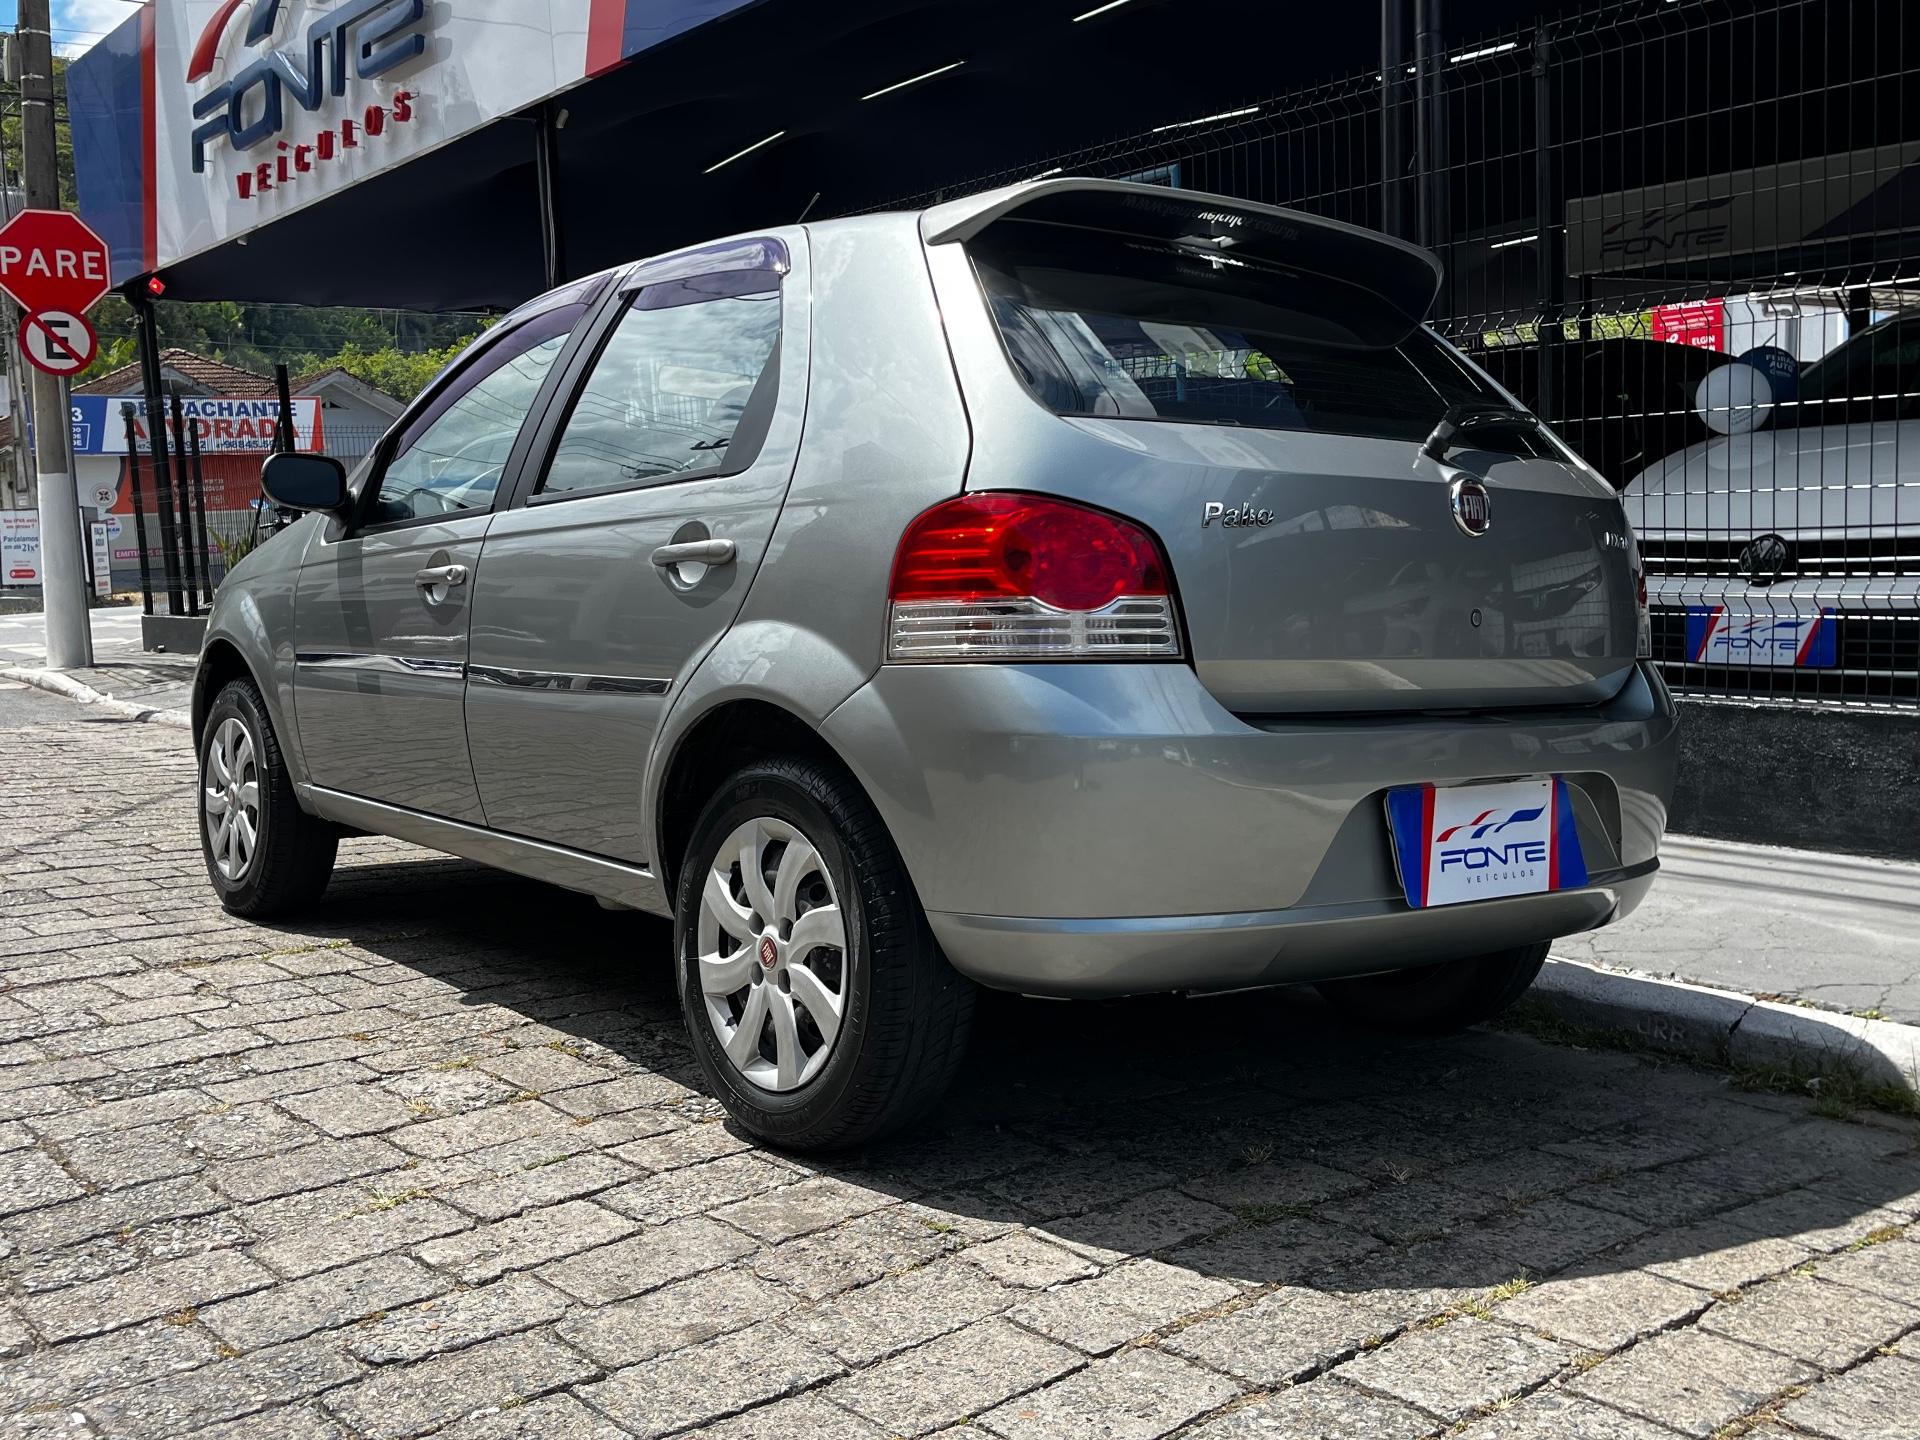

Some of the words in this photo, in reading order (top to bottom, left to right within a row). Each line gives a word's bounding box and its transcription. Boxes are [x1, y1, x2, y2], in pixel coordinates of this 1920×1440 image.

[192, 0, 425, 173] FONTE
[236, 91, 412, 199] VEÍCULOS
[1599, 224, 1728, 260] FONTE
[0, 246, 104, 280] PARE
[1202, 501, 1275, 528] Palio
[1463, 494, 1485, 520] FIAT
[1713, 637, 1800, 649] FONTE
[1441, 841, 1546, 873] FONTE
[1467, 869, 1534, 884] VEÍCULOS
[762, 943, 774, 963] FIAT
